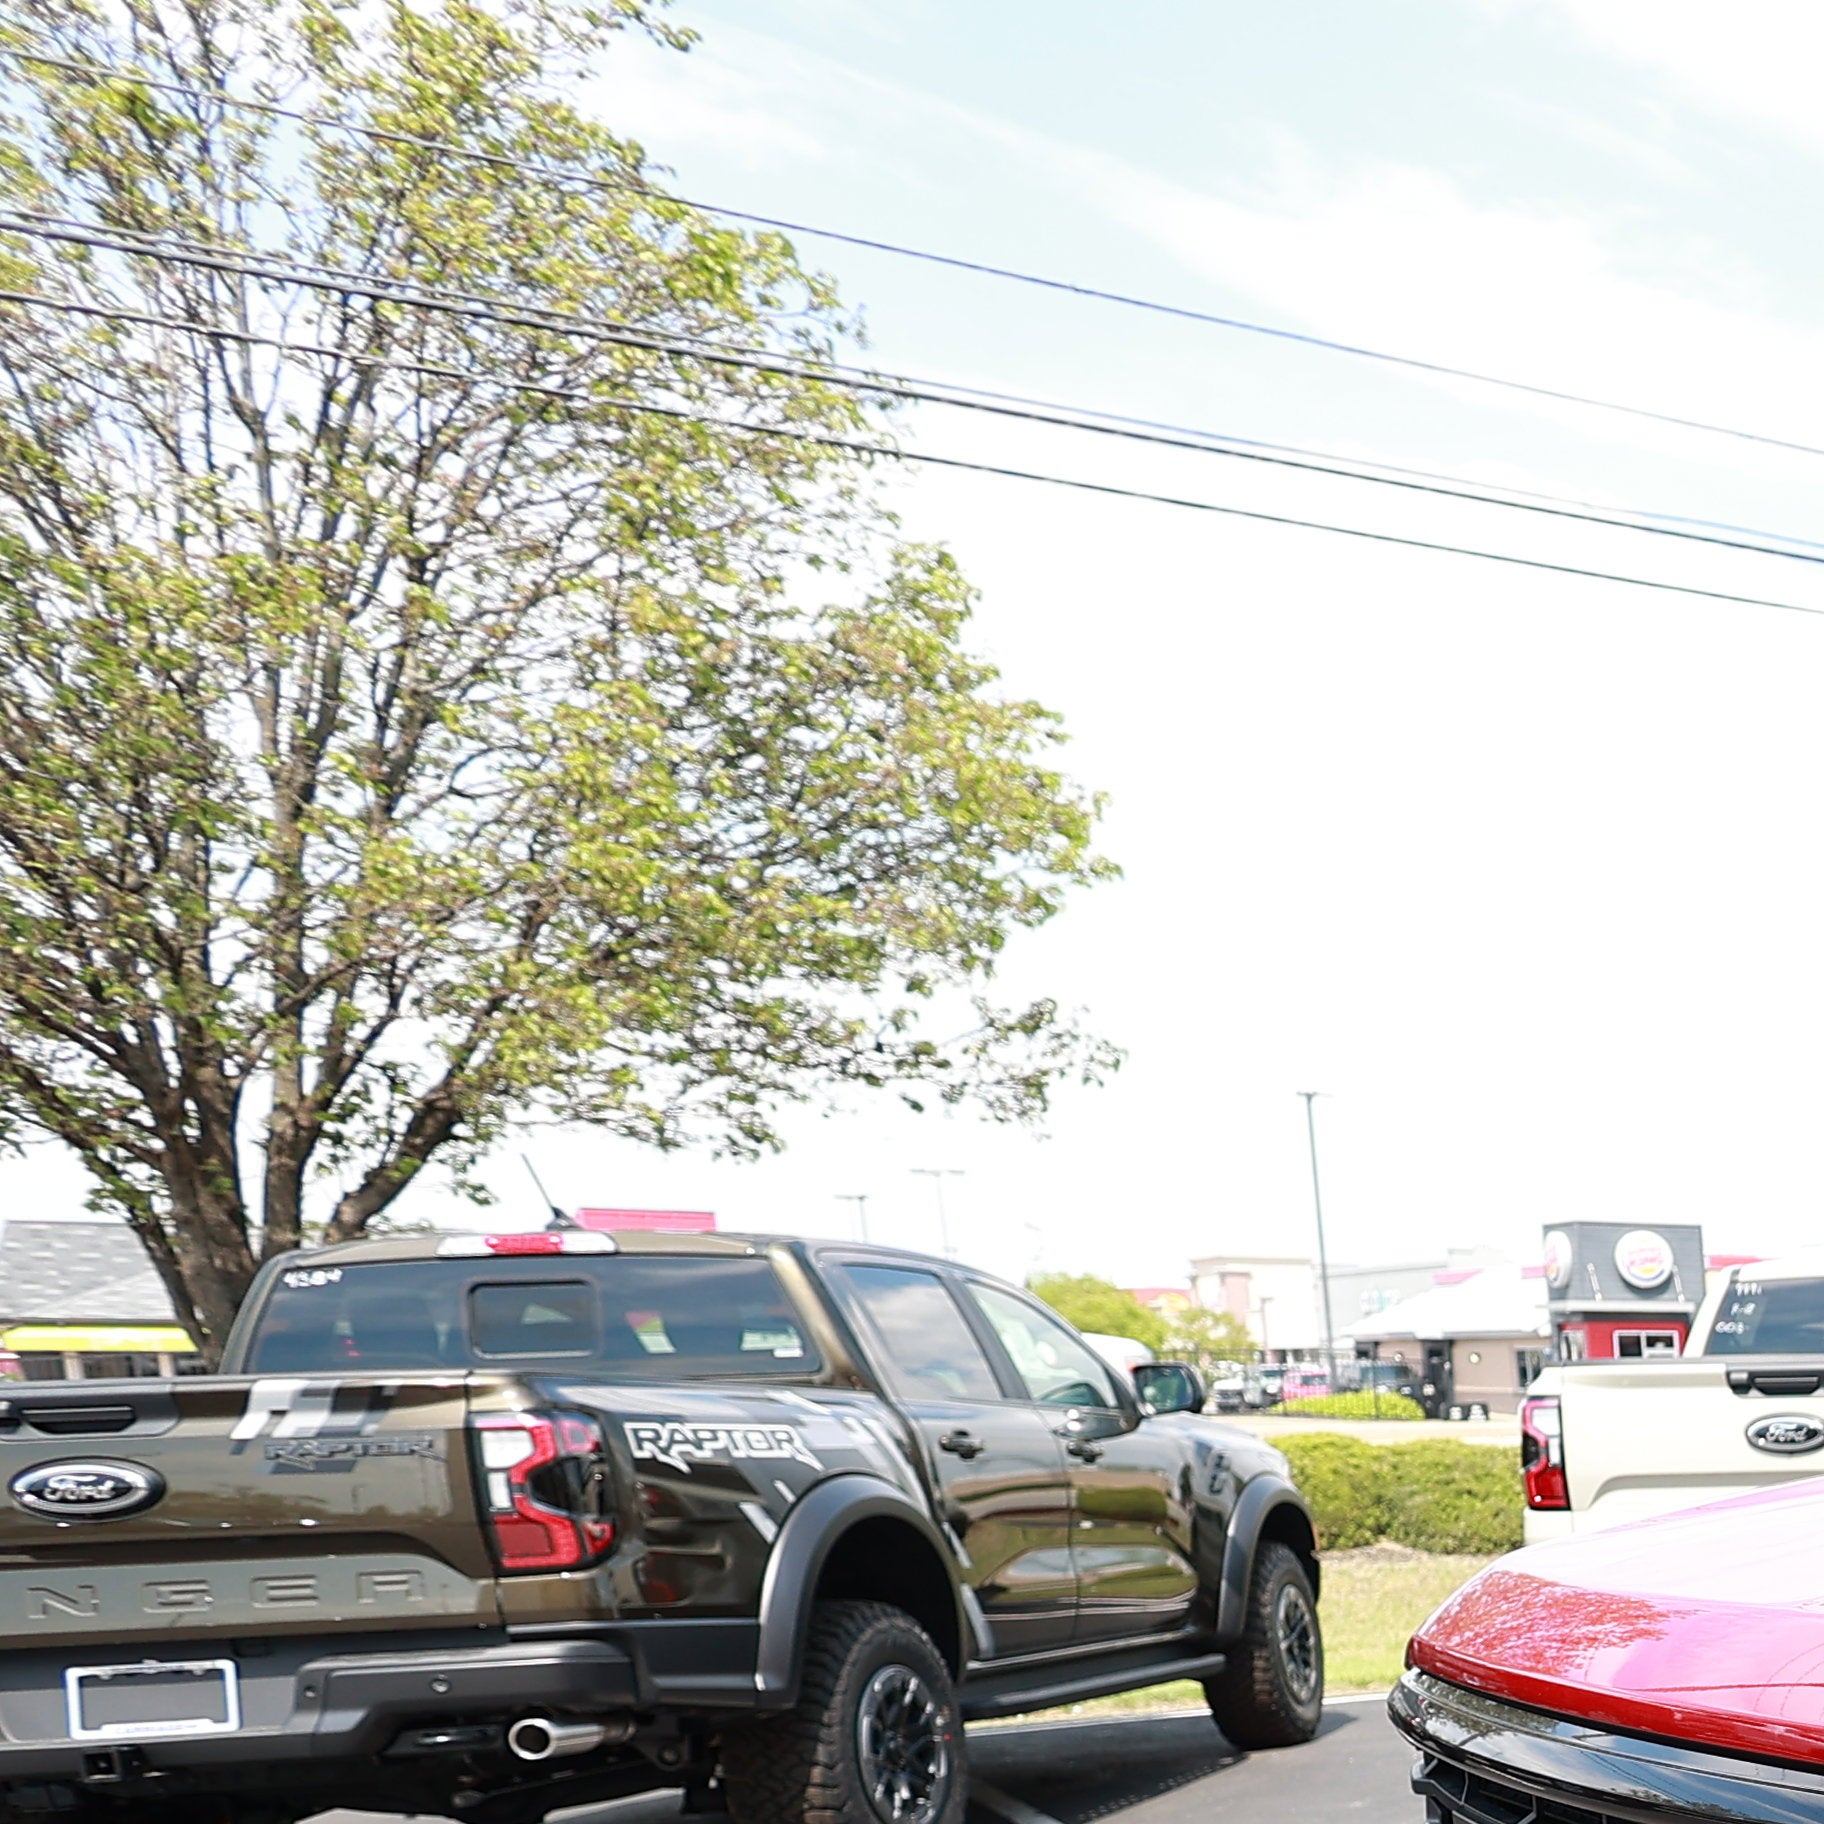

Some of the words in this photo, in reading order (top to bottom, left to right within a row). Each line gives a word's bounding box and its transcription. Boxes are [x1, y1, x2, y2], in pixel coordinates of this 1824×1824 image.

[1766, 1422, 1808, 1442] Ford
[265, 1435, 448, 1472] RAPTOR
[622, 1422, 826, 1476] RAPTOR
[43, 1474, 117, 1502] Ford
